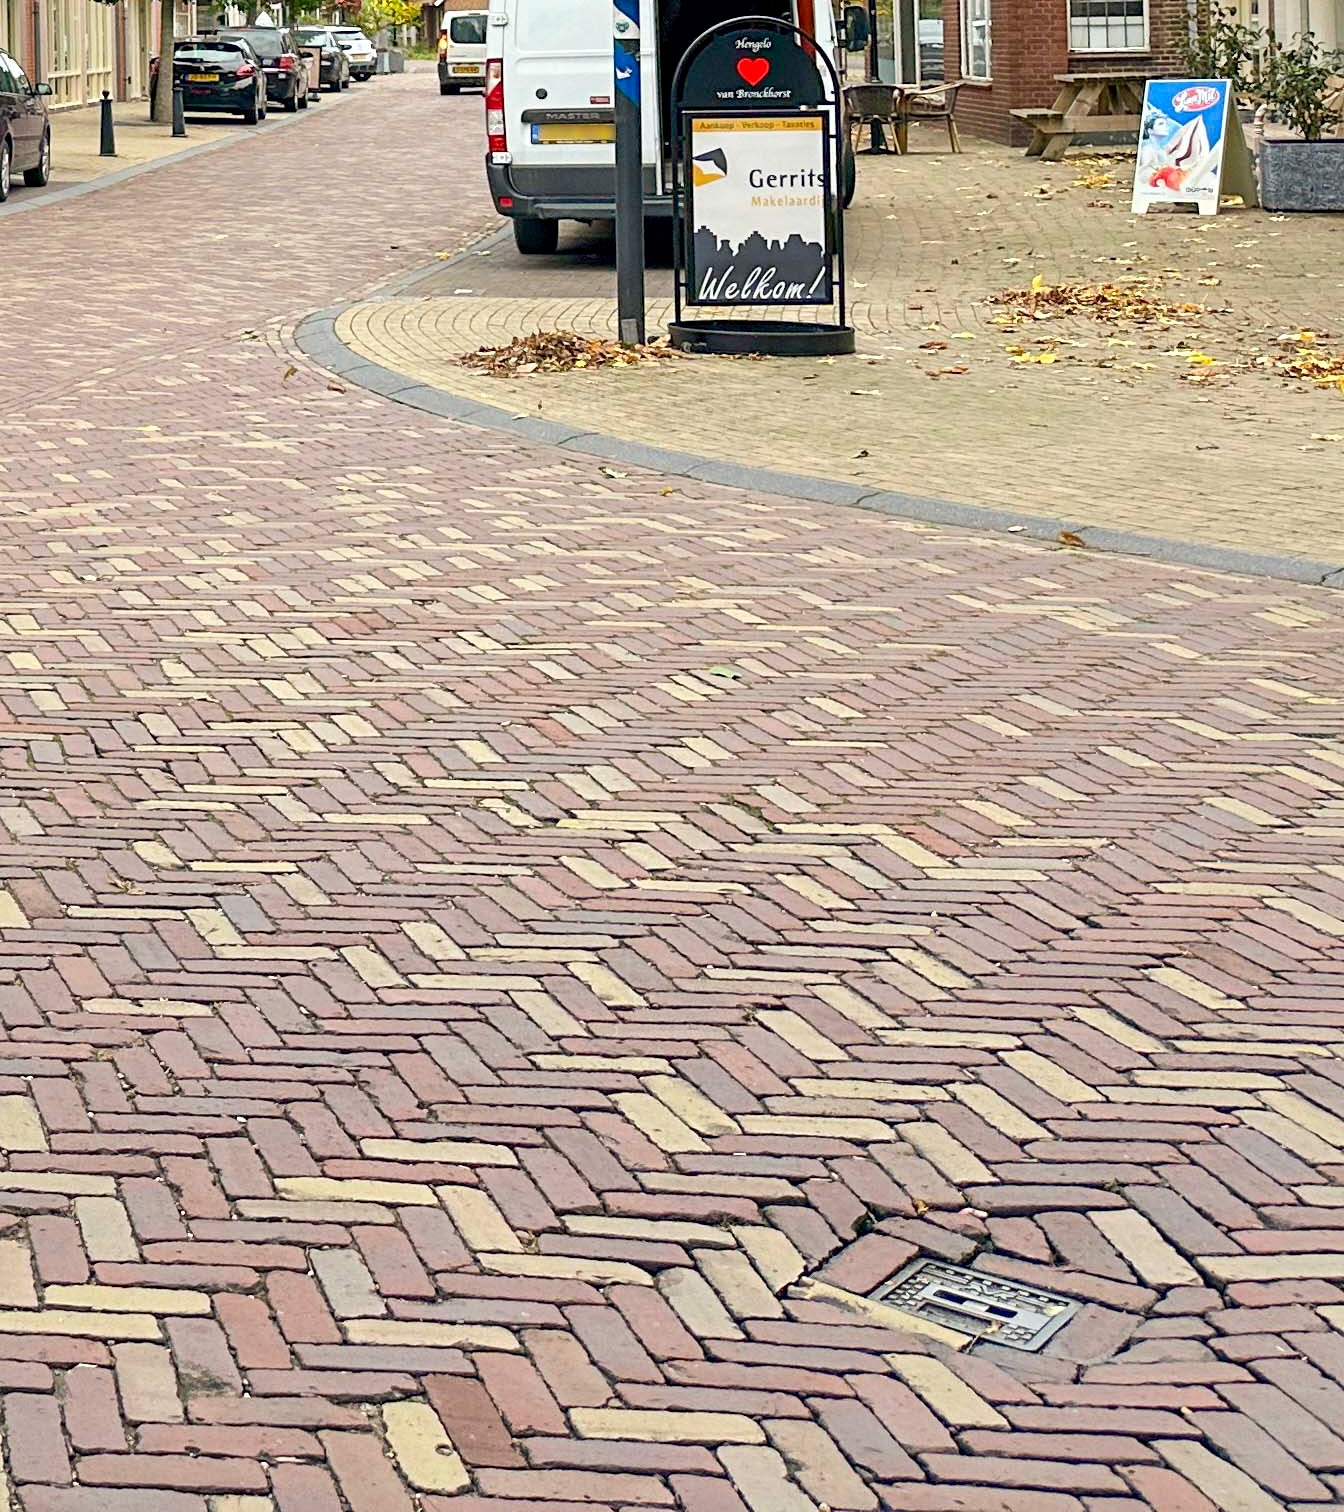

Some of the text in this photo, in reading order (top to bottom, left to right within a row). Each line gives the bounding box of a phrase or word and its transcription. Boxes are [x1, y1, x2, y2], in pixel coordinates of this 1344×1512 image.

[735, 37, 772, 53] Hengelo
[716, 87, 792, 99] van Bronckhorst
[545, 112, 601, 120] MASTER
[742, 121, 775, 130] Verkoop
[781, 120, 815, 129] Taxaties
[749, 168, 825, 189] Gerrits
[698, 265, 826, 300] Welkom!
